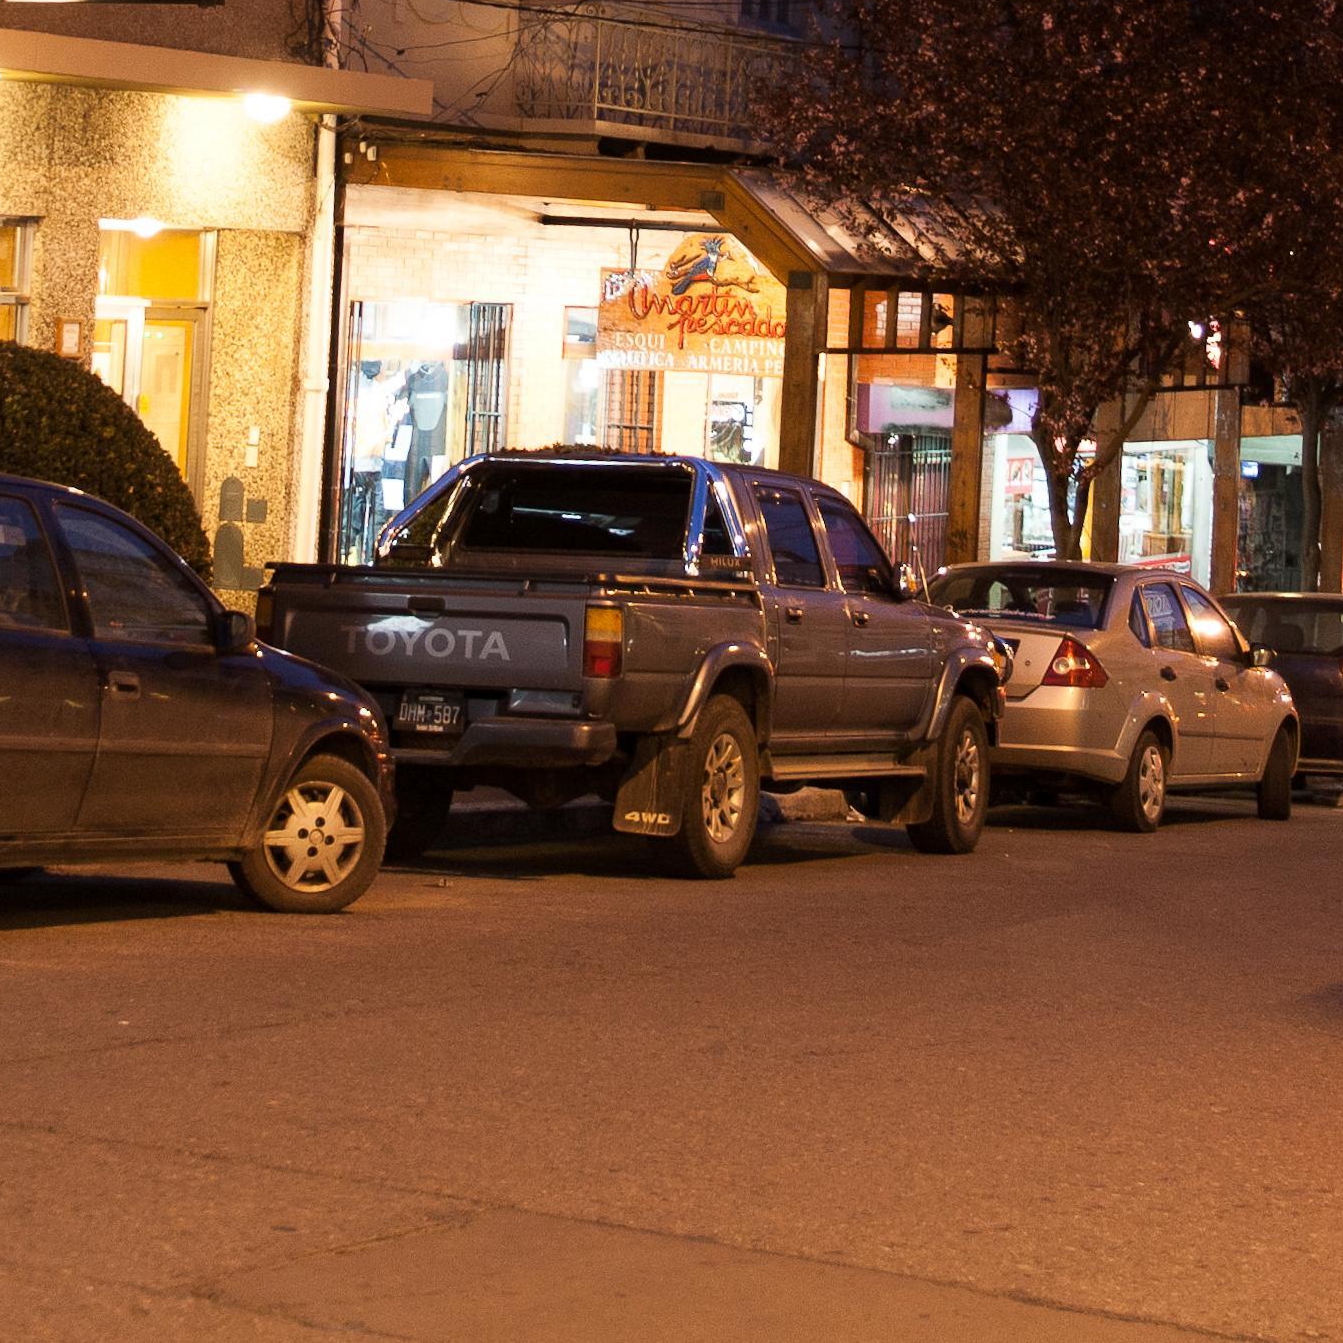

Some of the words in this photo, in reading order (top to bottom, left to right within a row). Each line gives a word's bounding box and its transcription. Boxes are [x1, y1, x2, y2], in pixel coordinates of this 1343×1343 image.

[615, 333, 666, 350] ESQUI
[342, 624, 511, 661] TOYOTA
[399, 702, 426, 722] DHM
[433, 705, 460, 724] 587
[624, 811, 670, 824] 4WD
